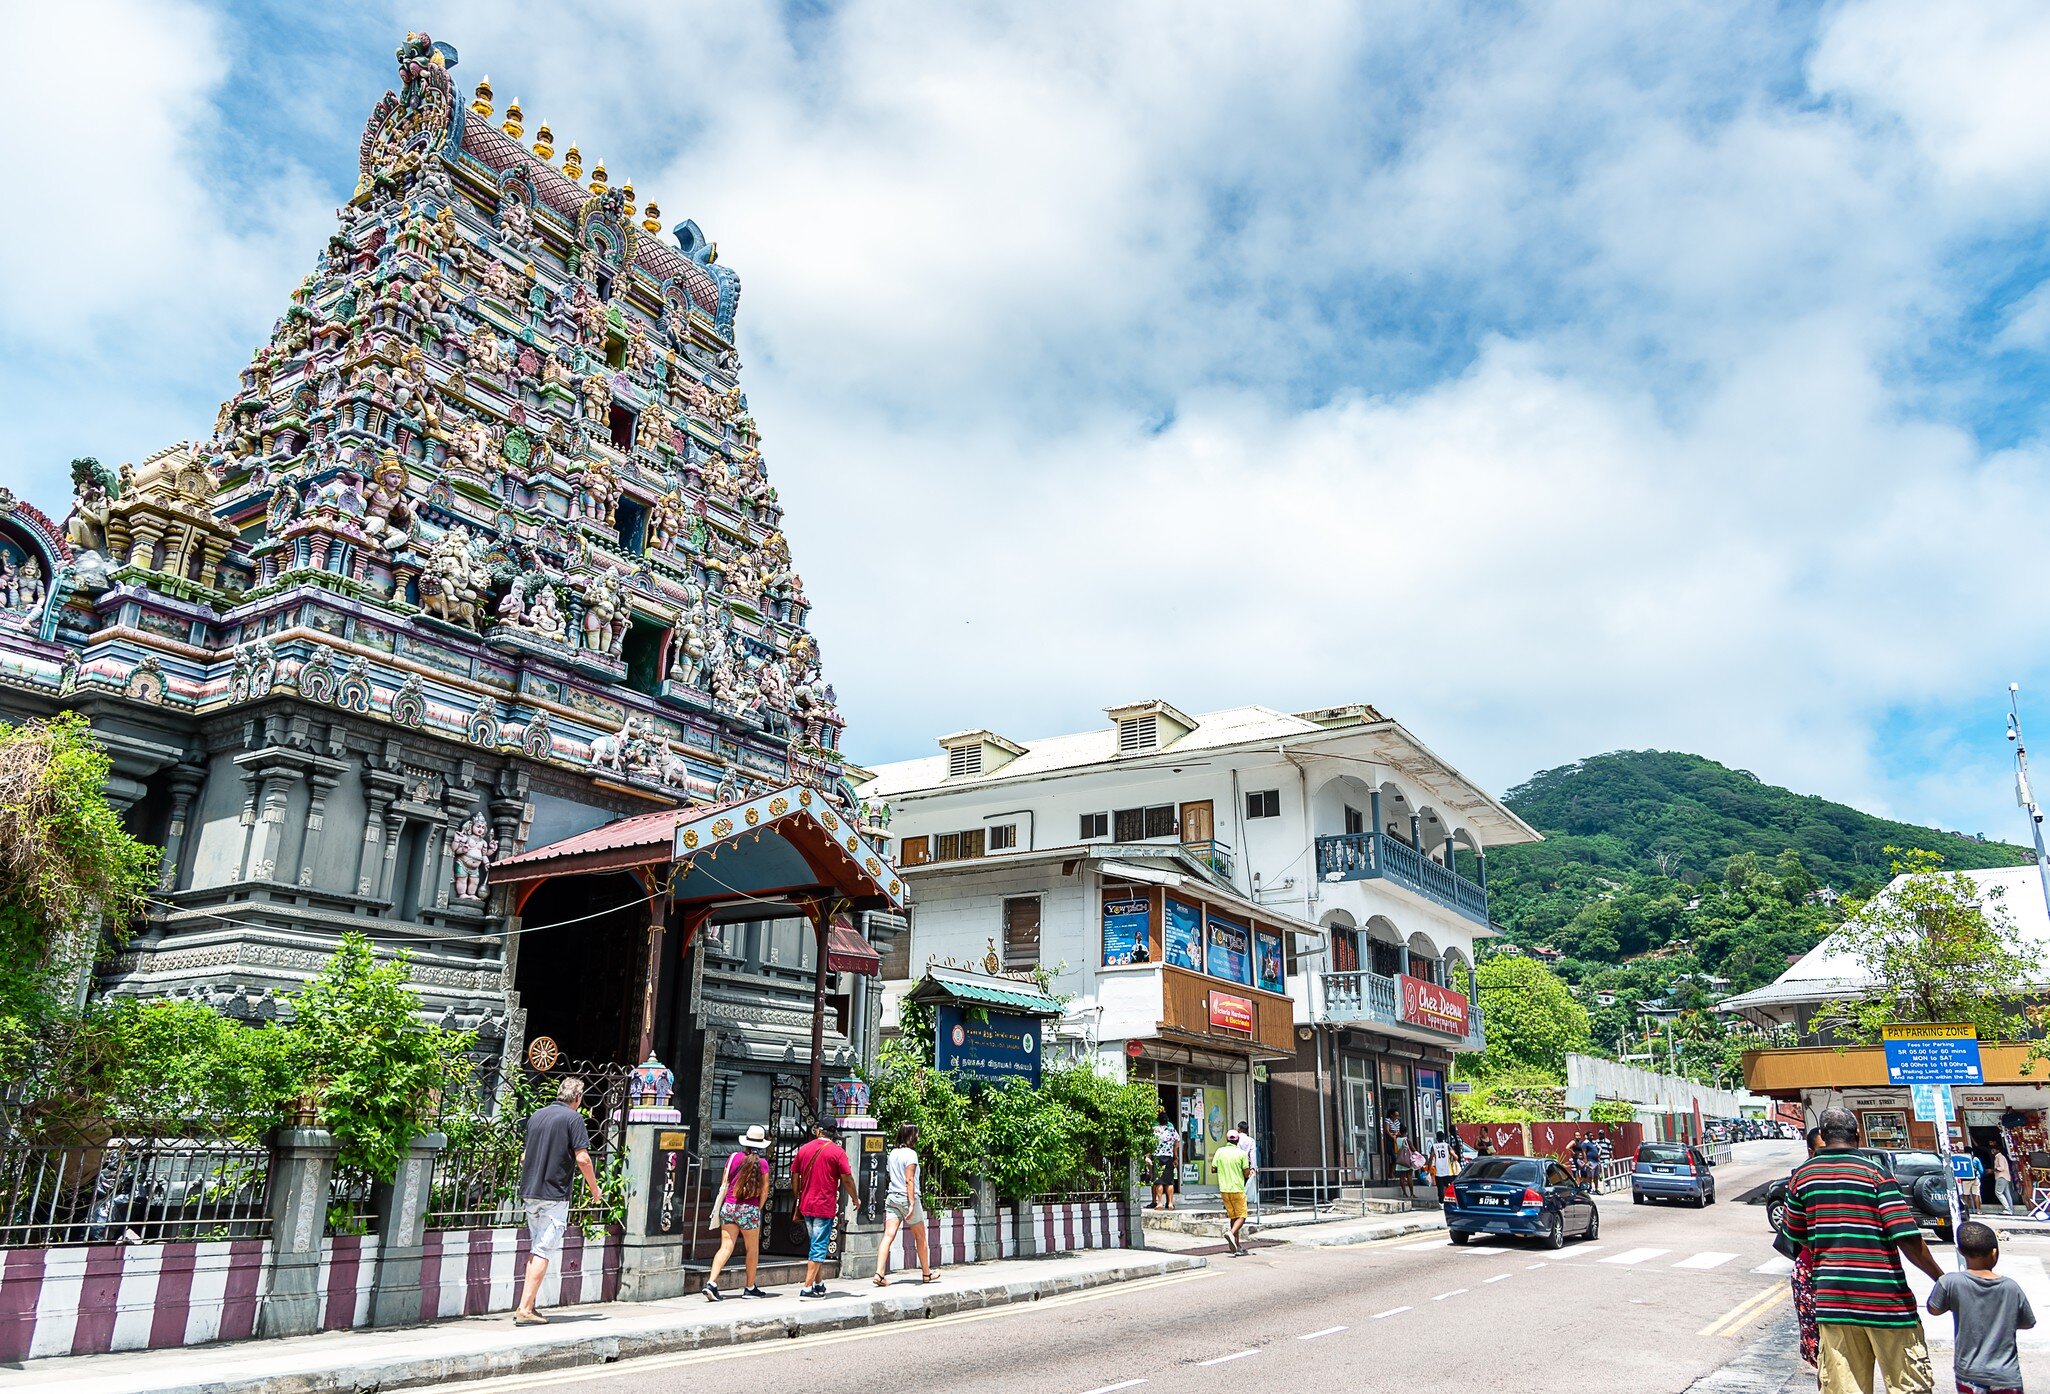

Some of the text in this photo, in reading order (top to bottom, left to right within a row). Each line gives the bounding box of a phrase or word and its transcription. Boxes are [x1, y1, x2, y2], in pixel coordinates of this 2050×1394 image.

[1259, 932, 1277, 946] GAMING
[1419, 985, 1438, 1012] Chez
[1225, 1015, 1229, 1023] &
[1230, 1008, 1250, 1021] Hardware
[1888, 1026, 1969, 1037] PAY PARKING ZONE
[1437, 1149, 1446, 1159] 16
[868, 1152, 879, 1221] SHKS
[1930, 1193, 1949, 1202] TERIO
